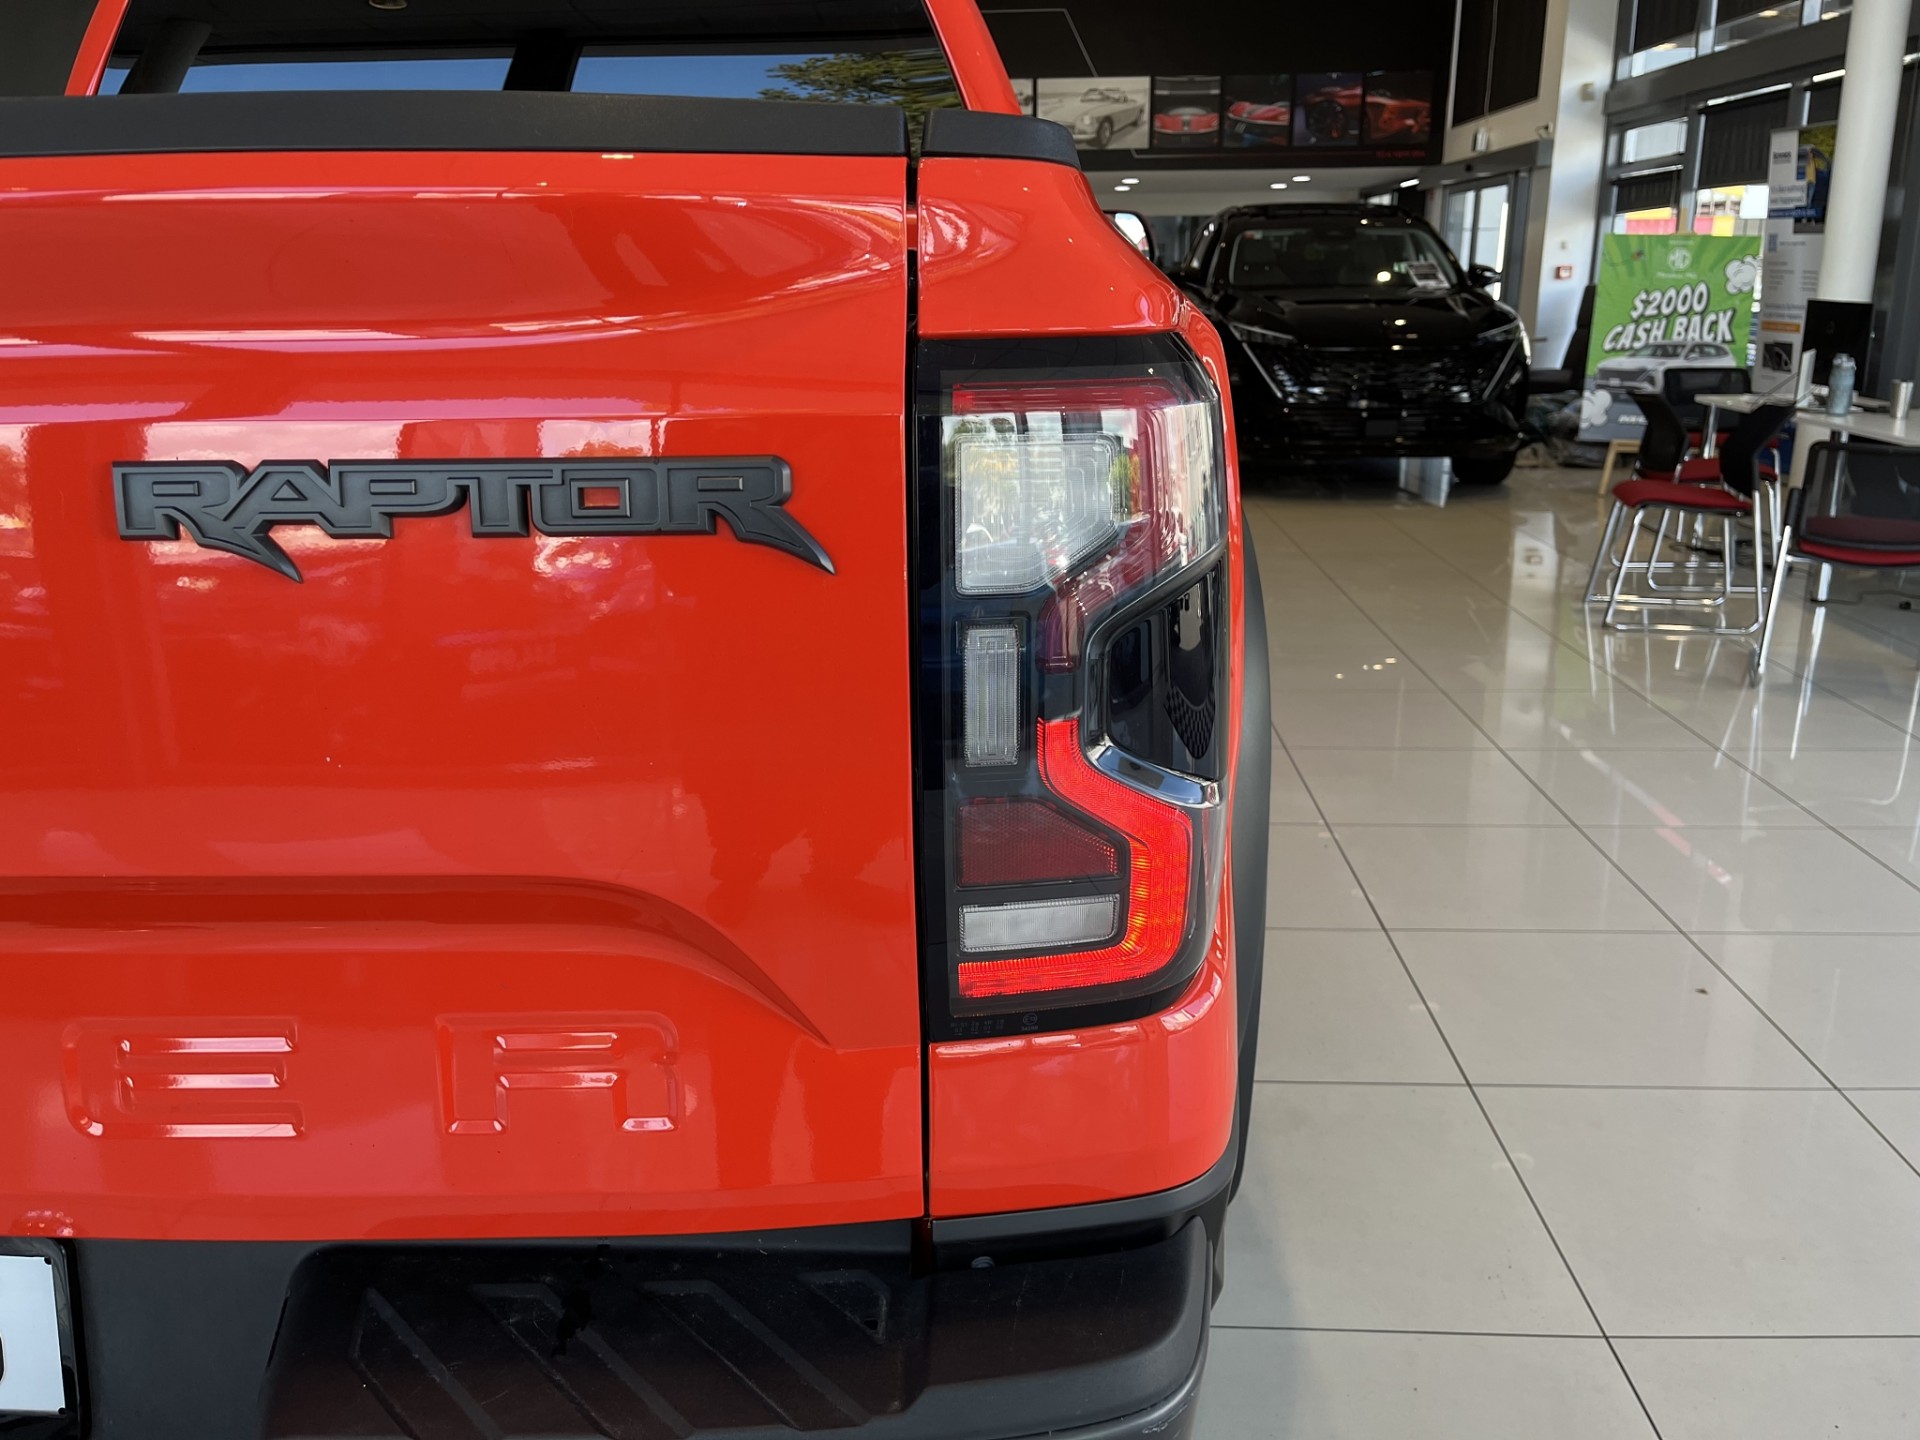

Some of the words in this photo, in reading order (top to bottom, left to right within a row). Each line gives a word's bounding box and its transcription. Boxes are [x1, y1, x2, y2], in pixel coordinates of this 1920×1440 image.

[1631, 281, 1708, 320] $2000
[1602, 319, 1667, 351] CASH
[1671, 308, 1735, 344] BACK
[112, 455, 836, 582] RAPTOR
